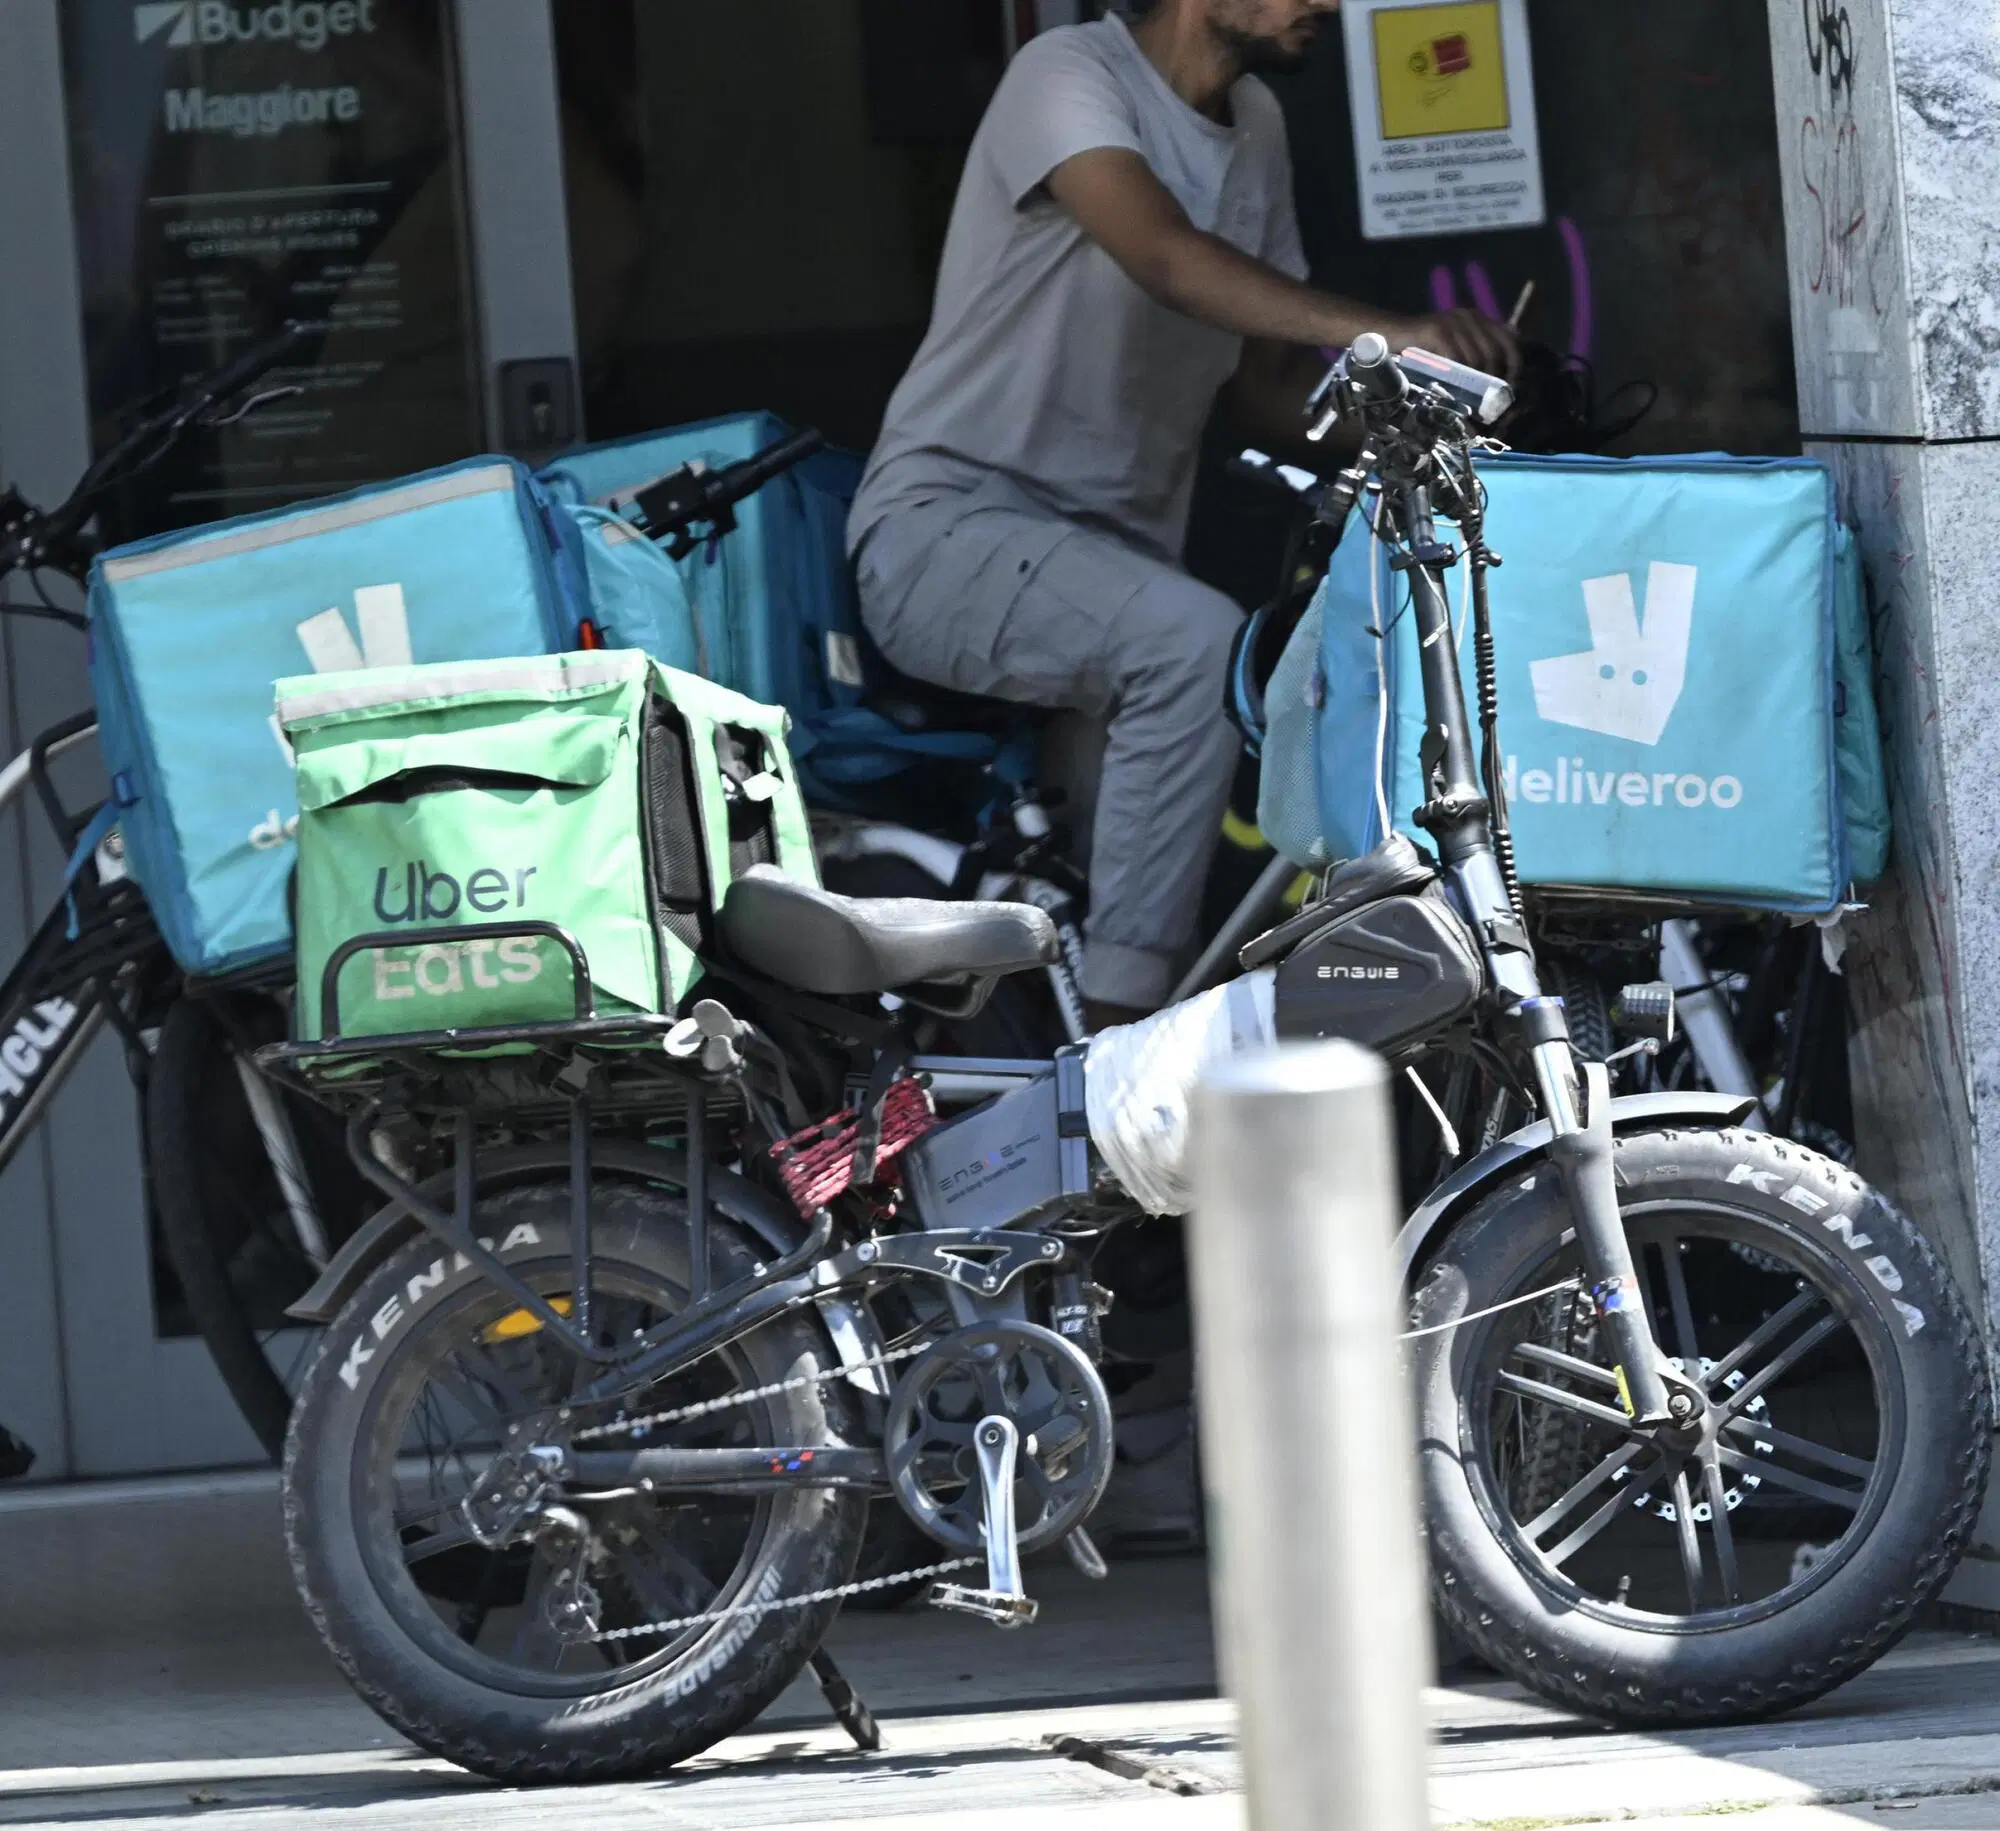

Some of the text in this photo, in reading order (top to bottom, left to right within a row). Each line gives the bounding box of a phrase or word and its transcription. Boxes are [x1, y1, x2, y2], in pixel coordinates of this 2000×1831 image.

[201, 0, 377, 49] Budget
[165, 82, 359, 136] Maggiore
[373, 860, 538, 924] Uber
[371, 935, 544, 1001] Eats
[1726, 1163, 1926, 1338] KENDA
